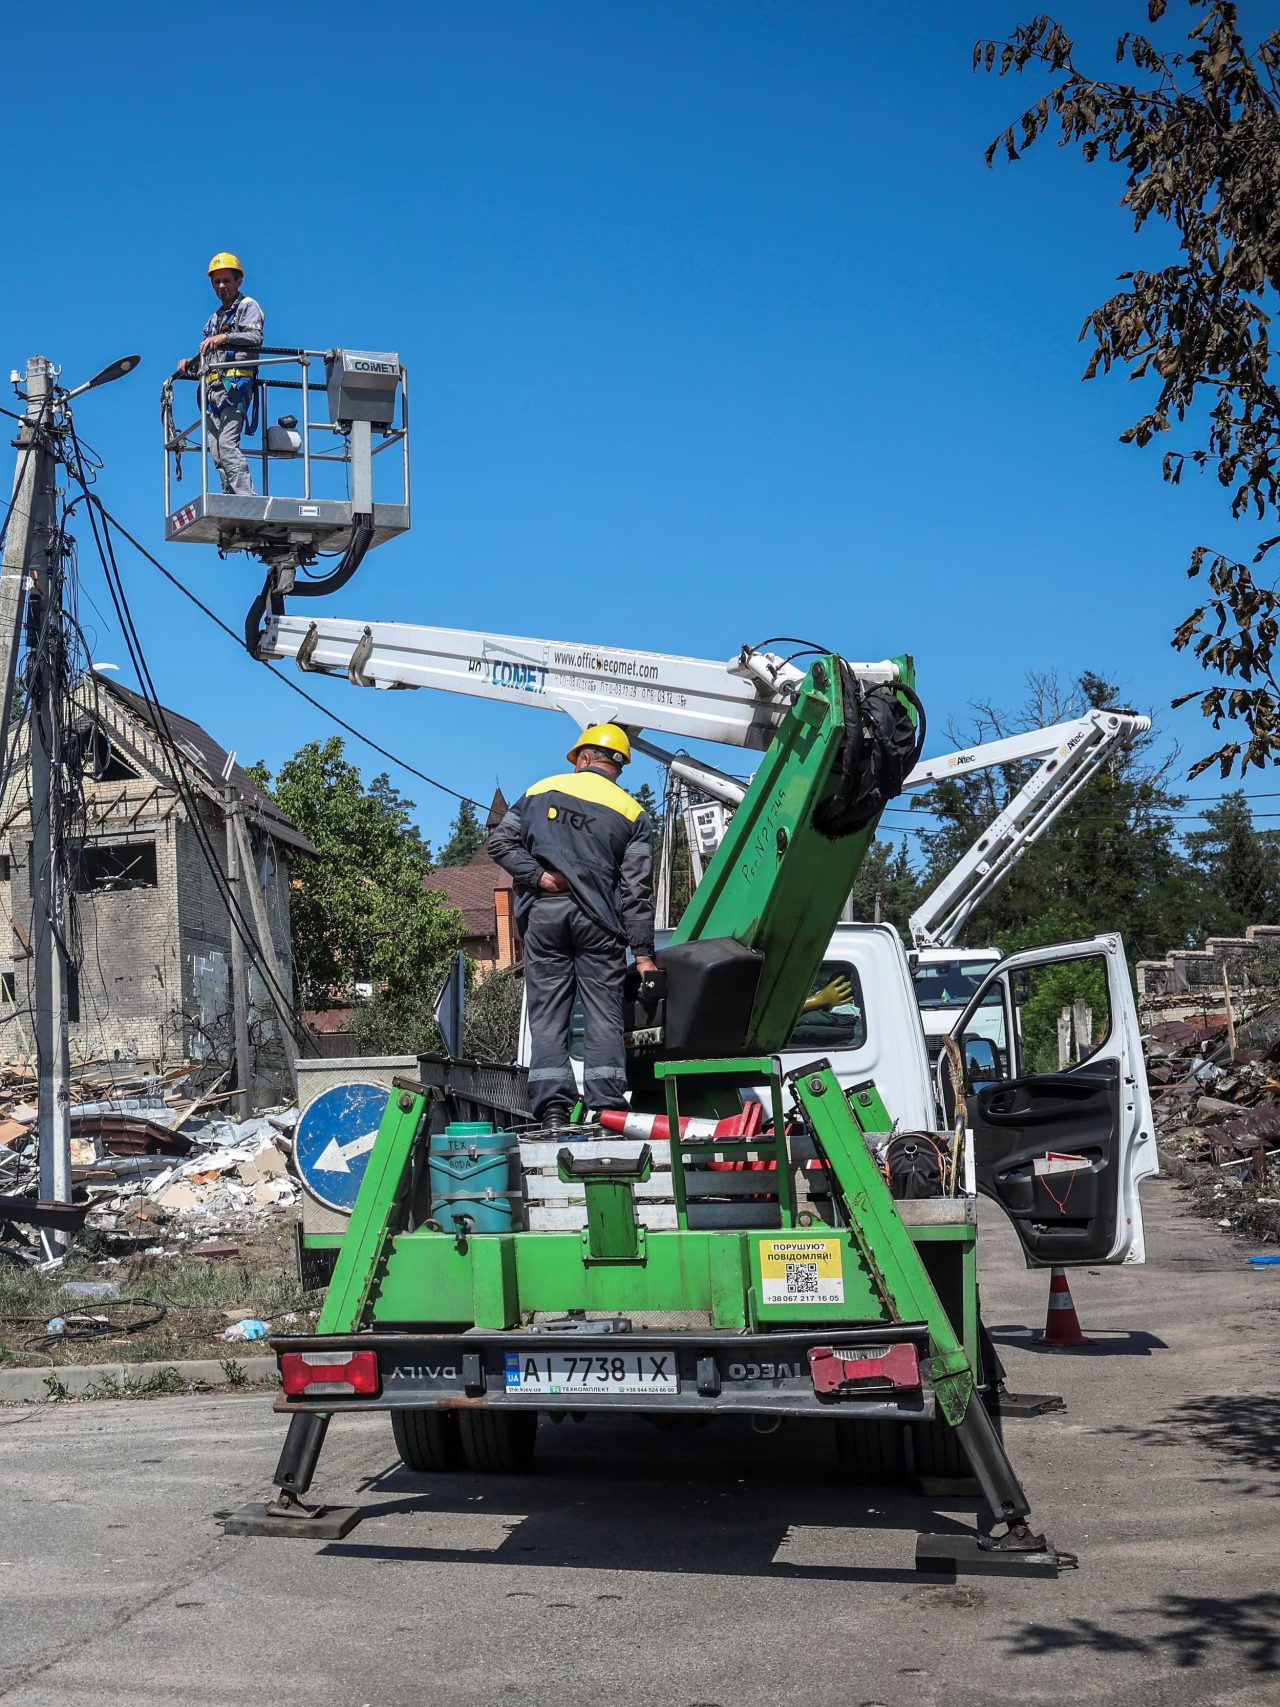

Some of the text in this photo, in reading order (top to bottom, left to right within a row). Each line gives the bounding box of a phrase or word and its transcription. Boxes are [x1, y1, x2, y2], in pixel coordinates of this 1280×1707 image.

[355, 361, 398, 374] COMET
[553, 650, 659, 680] www.officiecomet.com
[492, 659, 550, 695] COMET
[1066, 731, 1085, 750] Altec
[957, 754, 976, 765] Altec
[773, 1243, 825, 1251] ПОРУШУЮ?
[768, 1252, 832, 1261] ПОВІДОМЛЯЙ!
[391, 1366, 457, 1380] DAILY
[523, 1356, 669, 1383] AI 7738 IX
[728, 1363, 802, 1379] IVECO
[508, 1374, 519, 1383] UA
